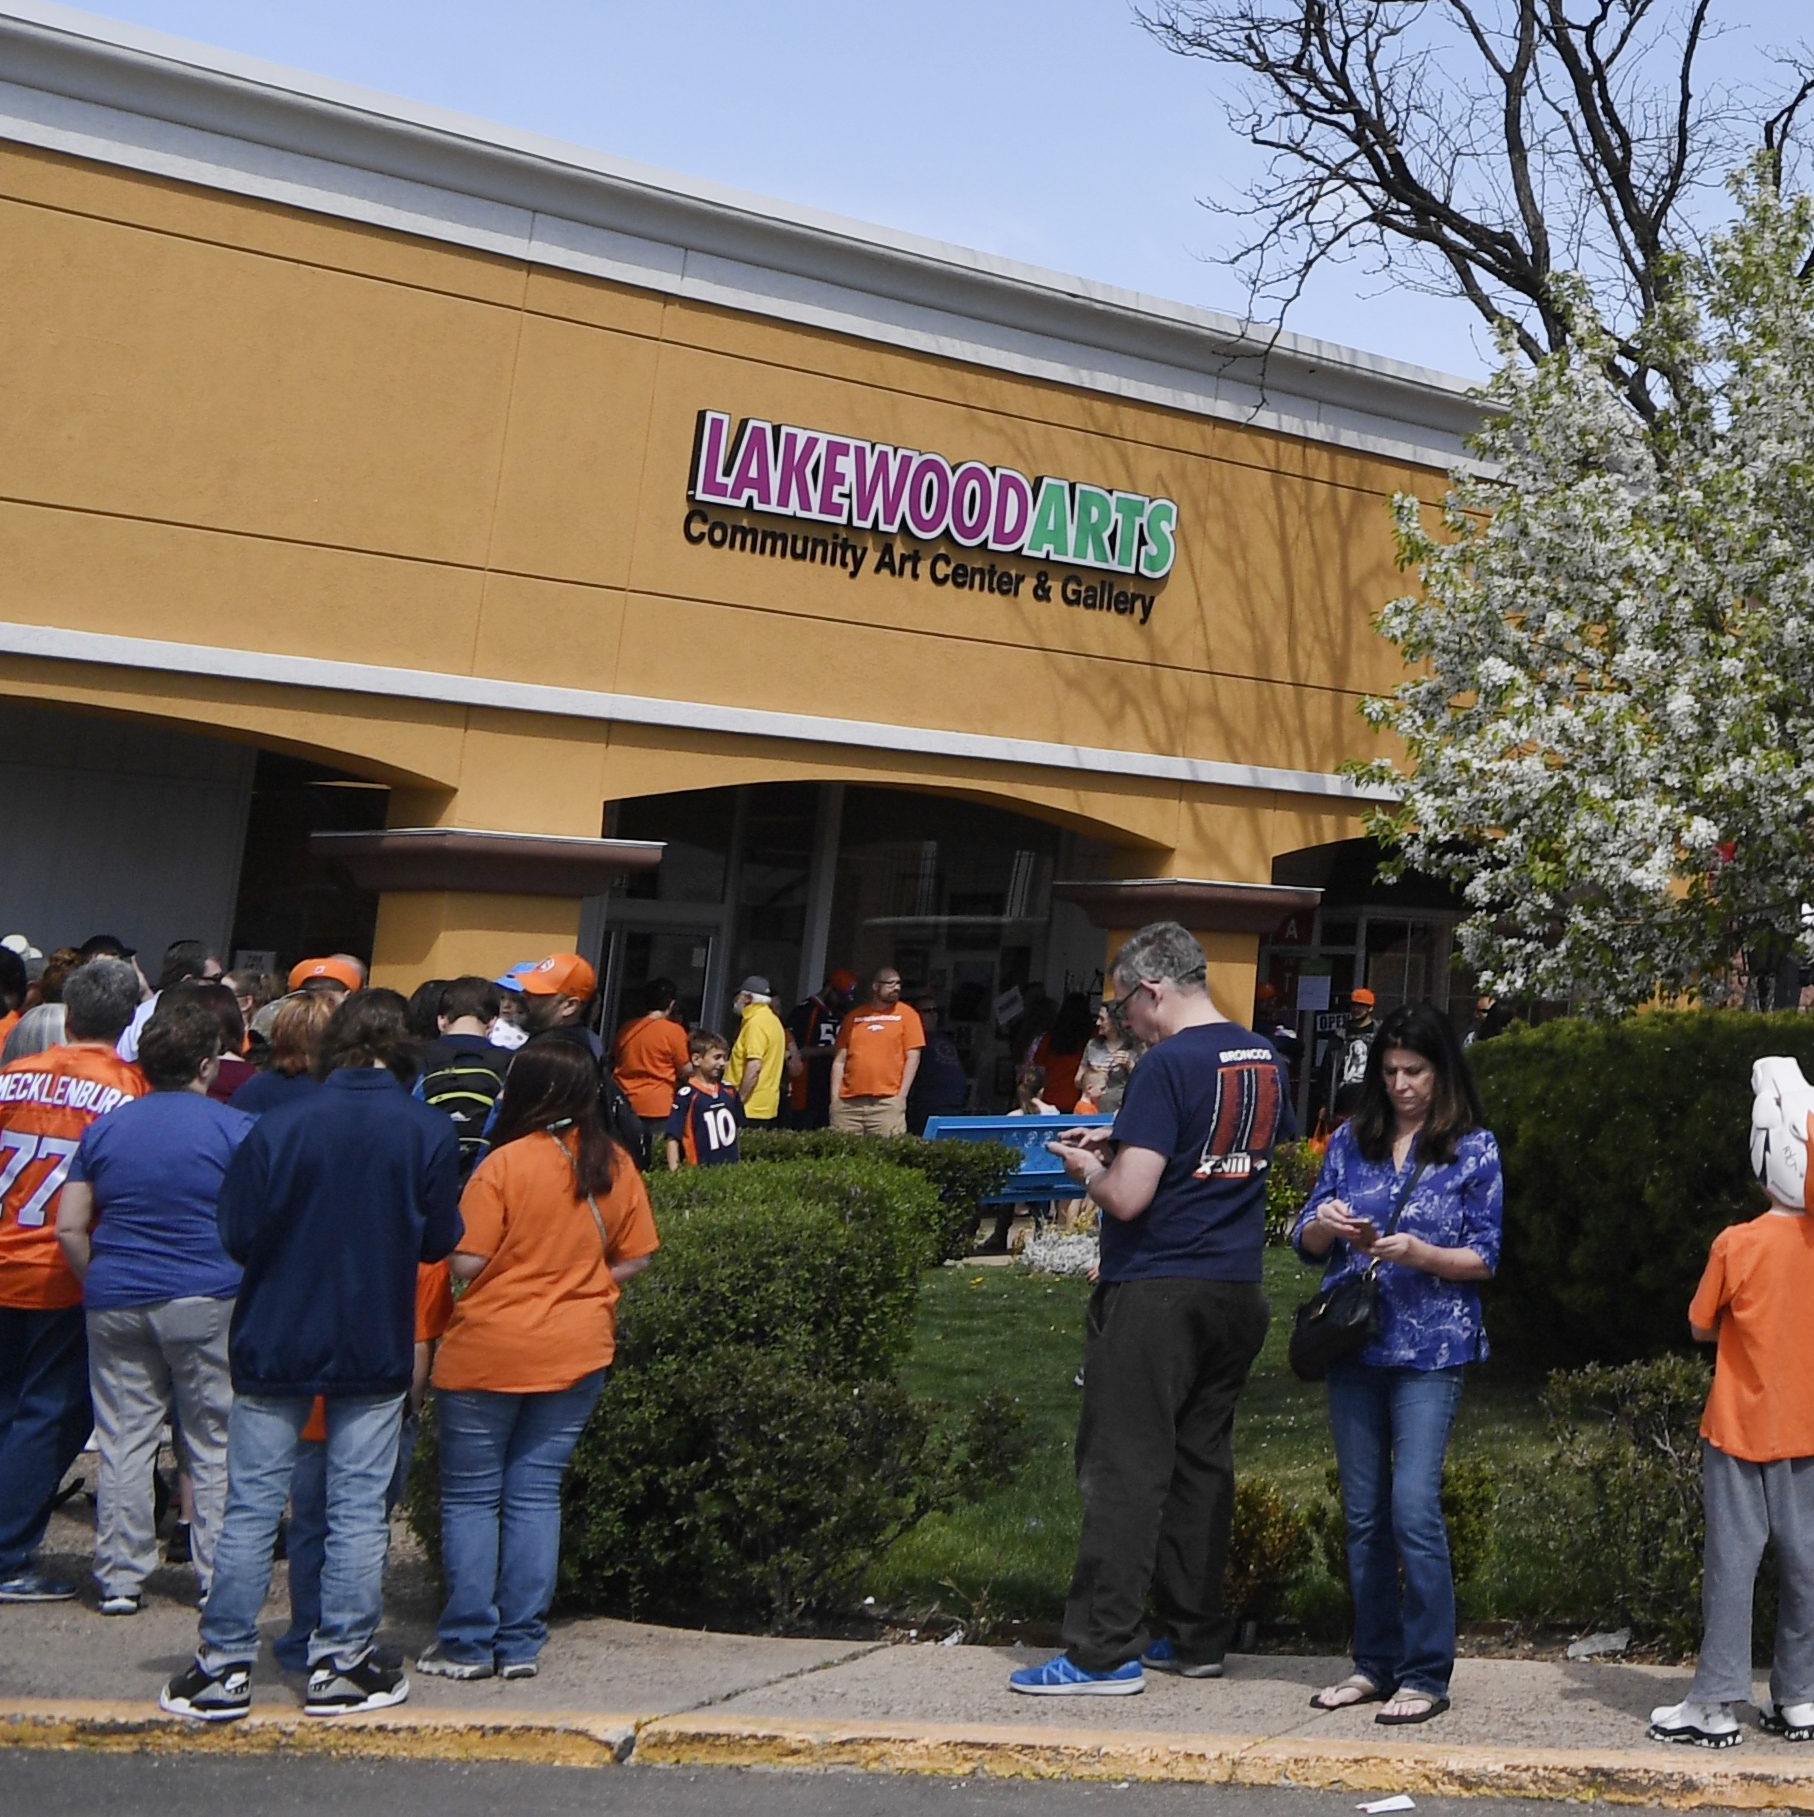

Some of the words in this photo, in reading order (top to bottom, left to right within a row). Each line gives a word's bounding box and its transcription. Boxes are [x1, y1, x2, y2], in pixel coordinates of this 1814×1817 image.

[684, 509, 867, 578] Community
[875, 544, 920, 580] Art
[930, 554, 1026, 598] Center
[1033, 573, 1052, 603] &
[1061, 575, 1155, 624] Gallery
[1219, 1049, 1272, 1063] BRONCOS
[703, 1108, 736, 1150] 10
[0, 1128, 80, 1226] 77
